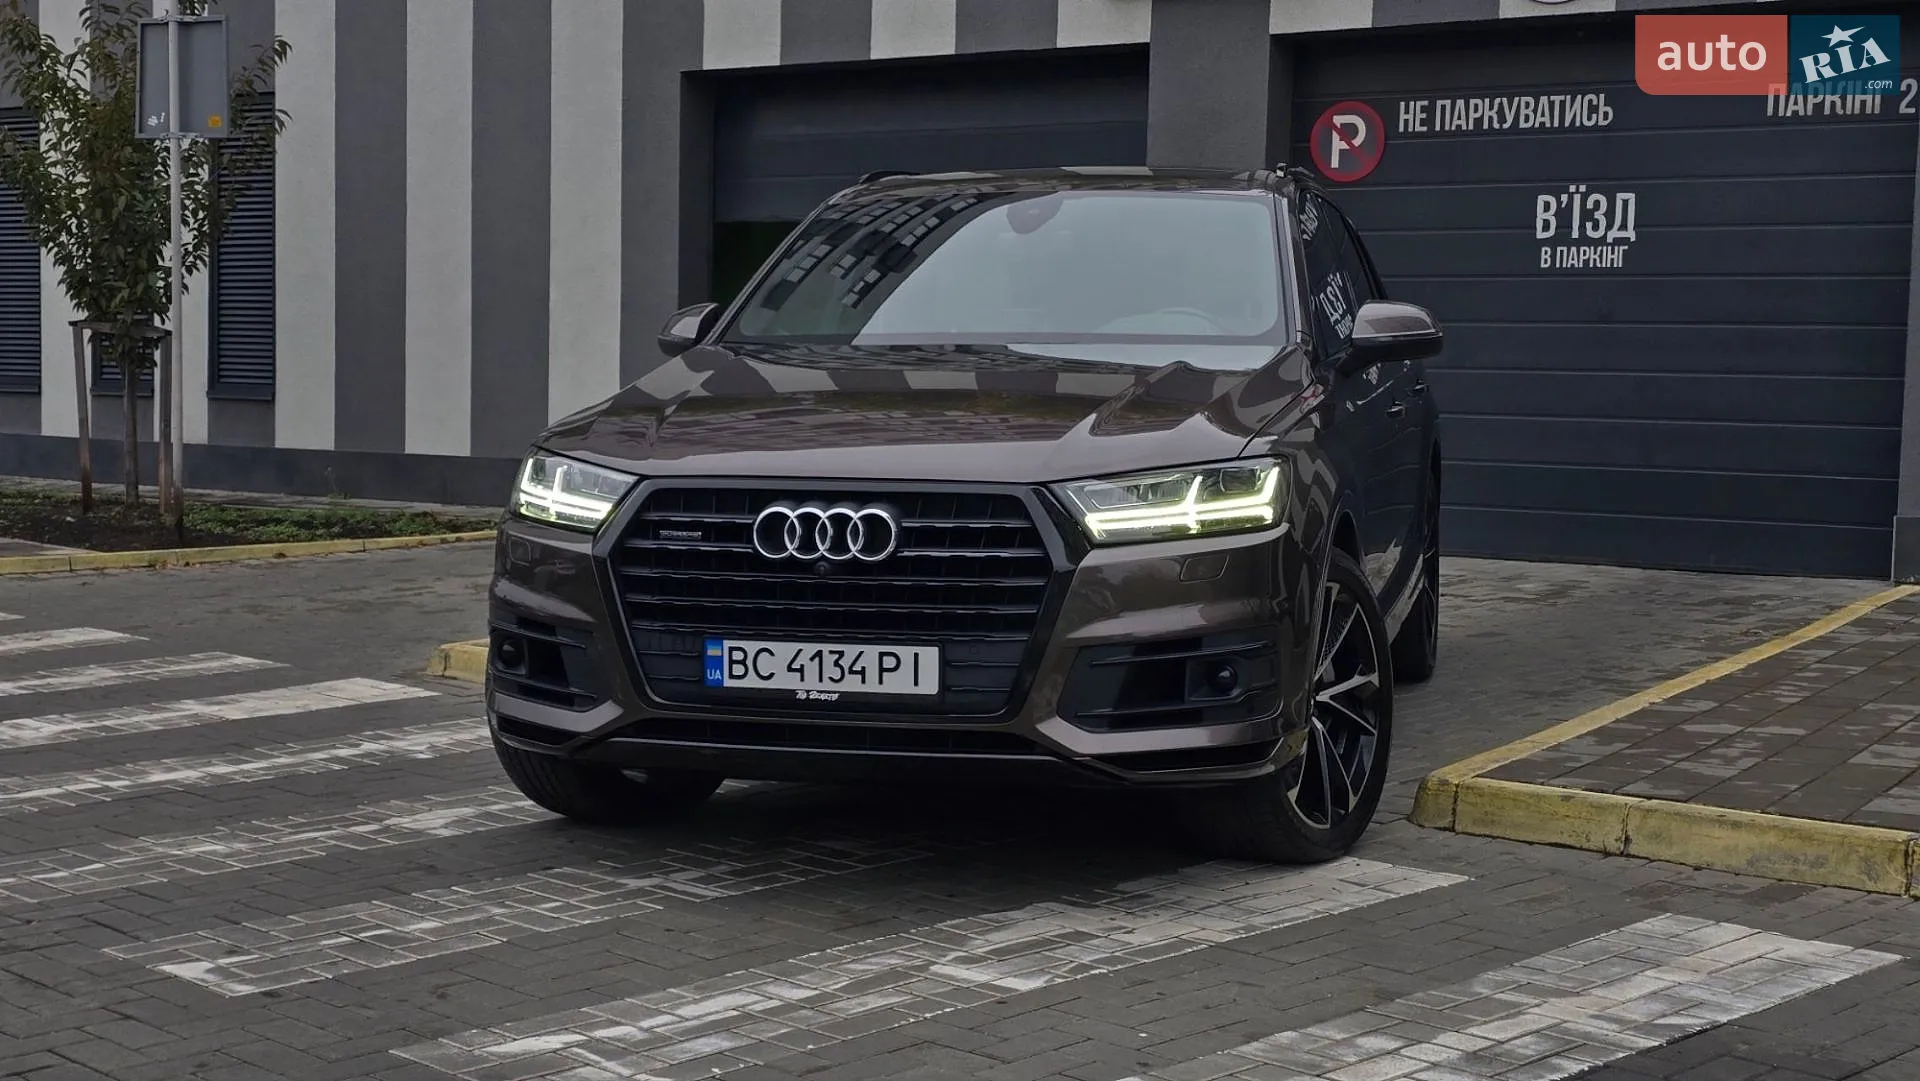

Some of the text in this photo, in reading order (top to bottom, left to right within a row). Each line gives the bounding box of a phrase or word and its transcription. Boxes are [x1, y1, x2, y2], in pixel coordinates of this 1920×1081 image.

[1398, 93, 1614, 133] НЕ ПАРКУВАТИСЬ
[1898, 78, 1919, 114] 2
[1535, 184, 1636, 243] В'ЇЗД
[1540, 245, 1629, 268] В ПАРКІНГ
[706, 668, 722, 680] UA
[728, 646, 776, 681] BC
[786, 648, 866, 685] 4134
